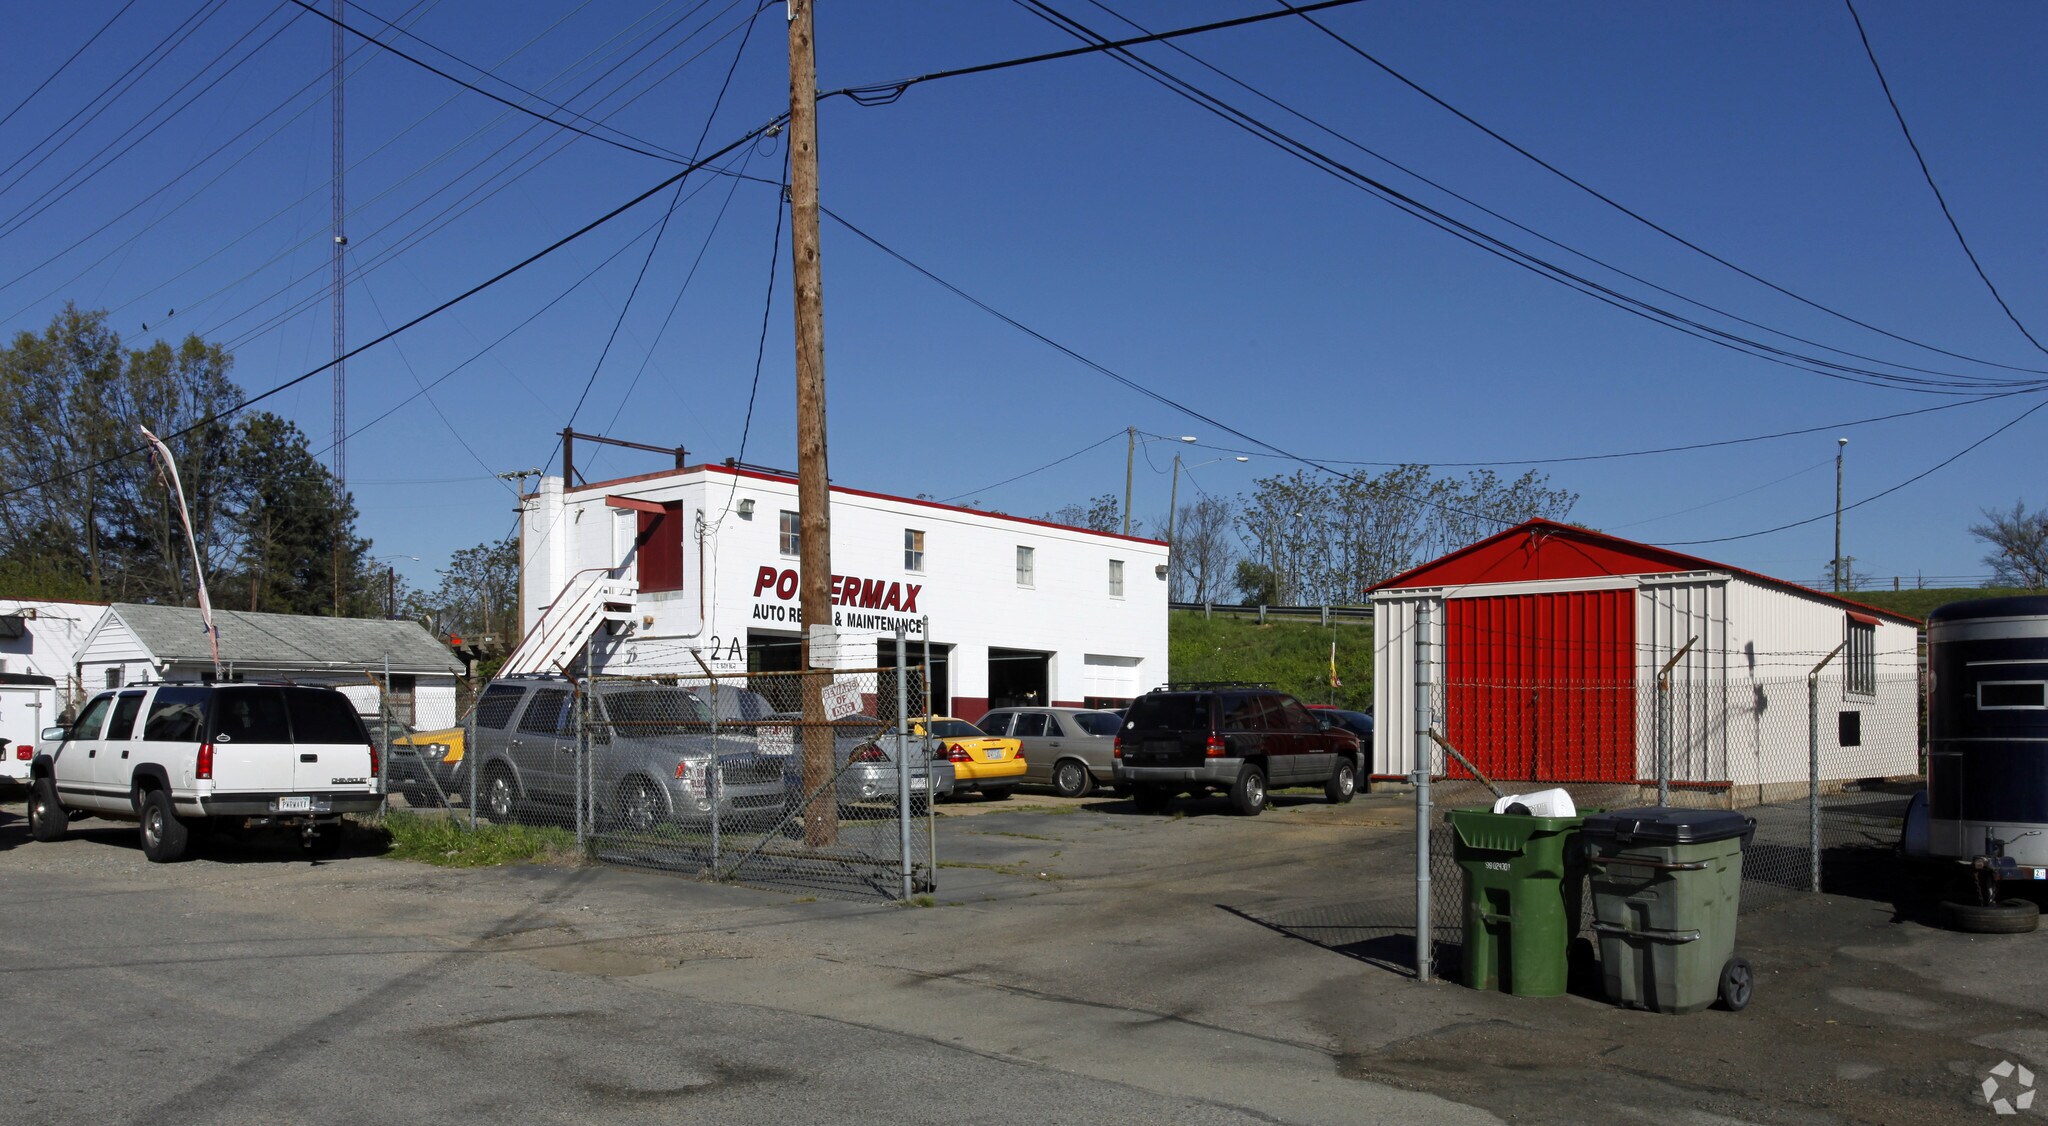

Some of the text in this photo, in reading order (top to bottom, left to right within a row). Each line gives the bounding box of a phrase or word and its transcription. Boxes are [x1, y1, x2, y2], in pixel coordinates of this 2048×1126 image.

[753, 565, 922, 613] POERMAX
[752, 604, 785, 622] AUTO
[835, 611, 842, 626] &
[847, 613, 922, 634] MAINTENANCE
[710, 635, 742, 661] 2 A
[835, 704, 852, 716] DOG
[836, 695, 847, 705] OF
